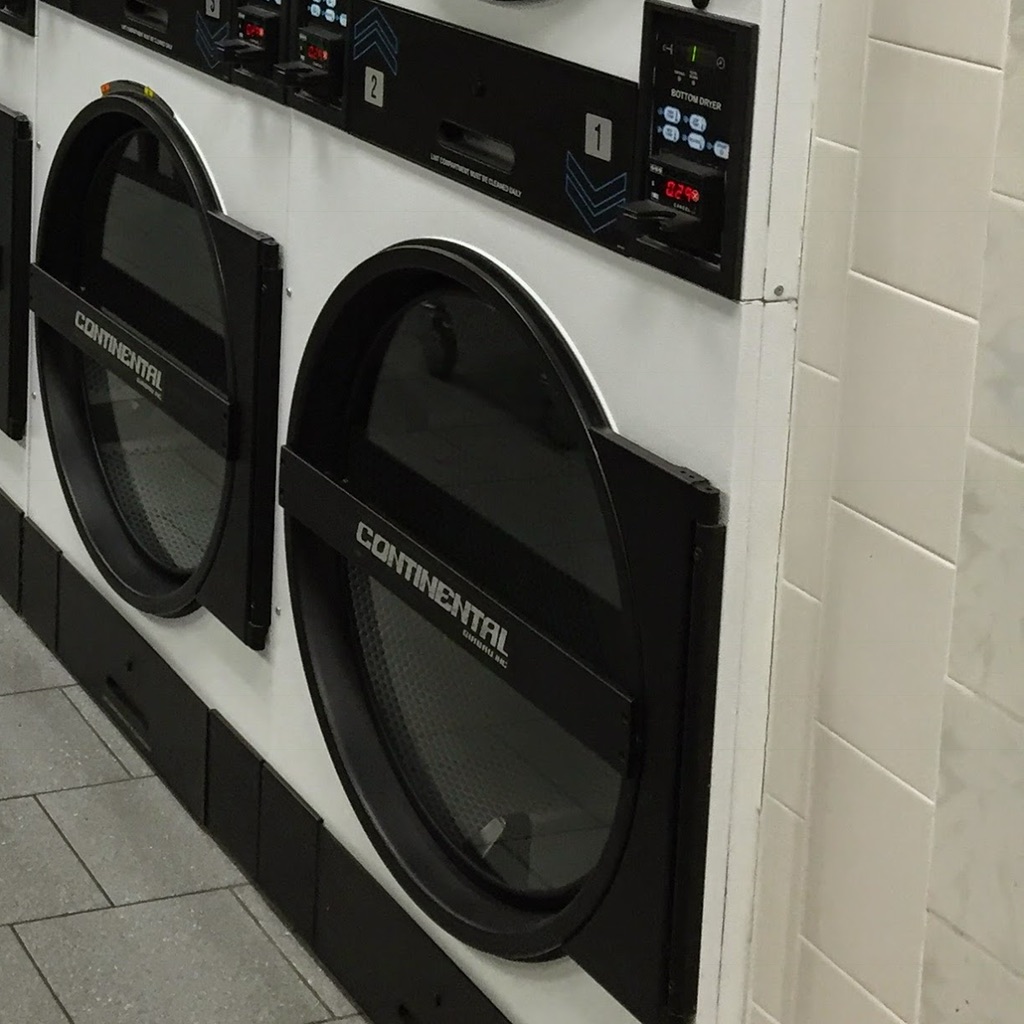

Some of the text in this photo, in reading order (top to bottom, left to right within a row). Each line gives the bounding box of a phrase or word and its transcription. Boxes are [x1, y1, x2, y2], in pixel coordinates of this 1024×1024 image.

[370, 74, 377, 99] 2
[670, 88, 722, 111] BOTTOM DRYER
[594, 123, 601, 152] 1
[75, 310, 162, 391] CONTINENTAL
[356, 521, 509, 658] CONTINENTAL
